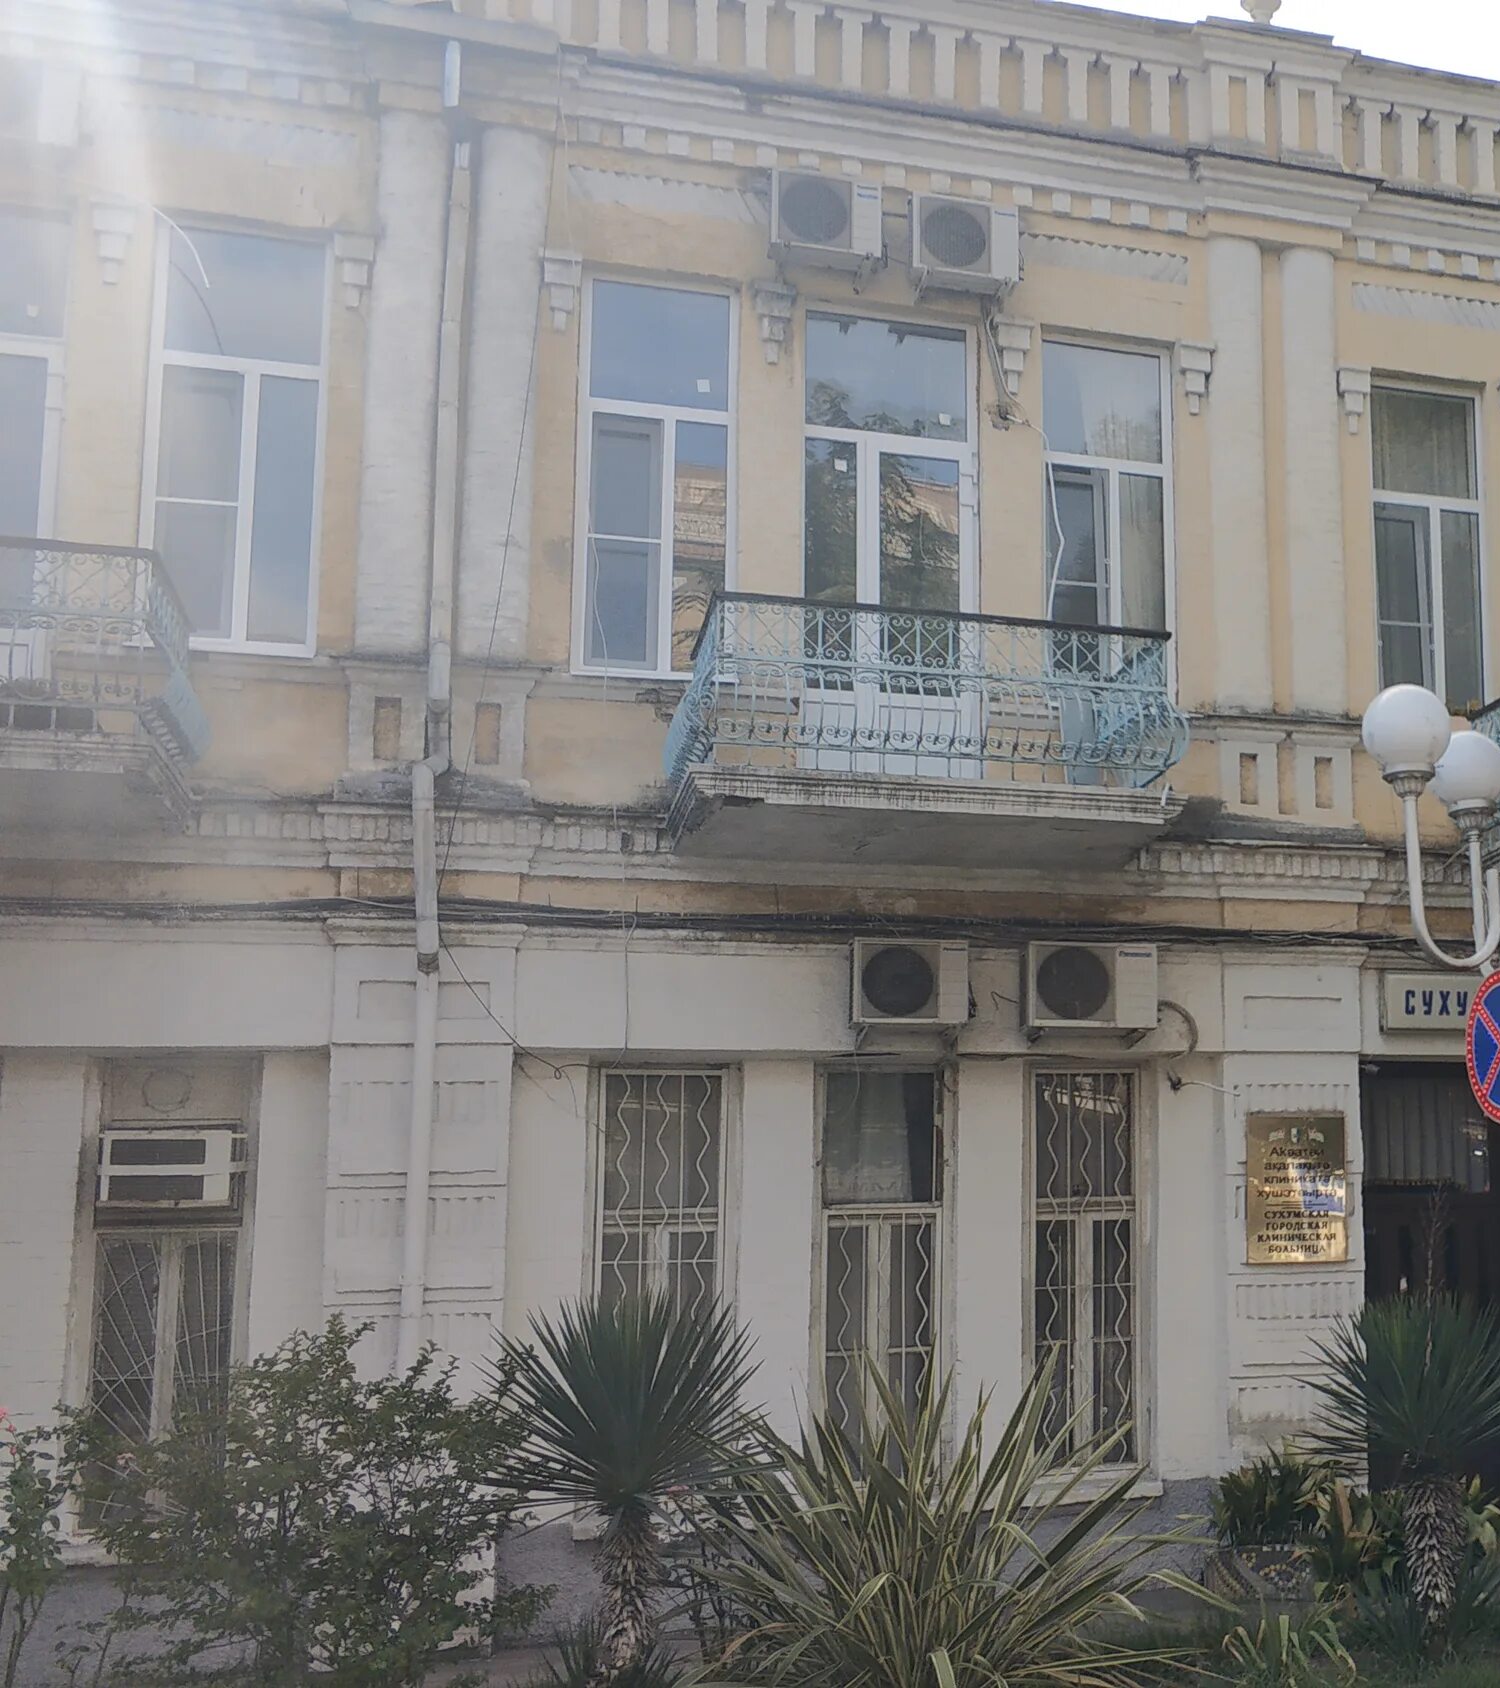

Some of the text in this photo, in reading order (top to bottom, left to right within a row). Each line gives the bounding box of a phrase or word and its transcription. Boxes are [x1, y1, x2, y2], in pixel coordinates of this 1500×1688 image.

[1264, 1209, 1329, 1219] СУХУМСКАЯ
[1265, 1221, 1329, 1231] ГОРОДСКАЯ
[1257, 1232, 1337, 1243] КЛИНИЧЕСКАЯ
[1268, 1244, 1326, 1254] БОЛЬНИЦА
